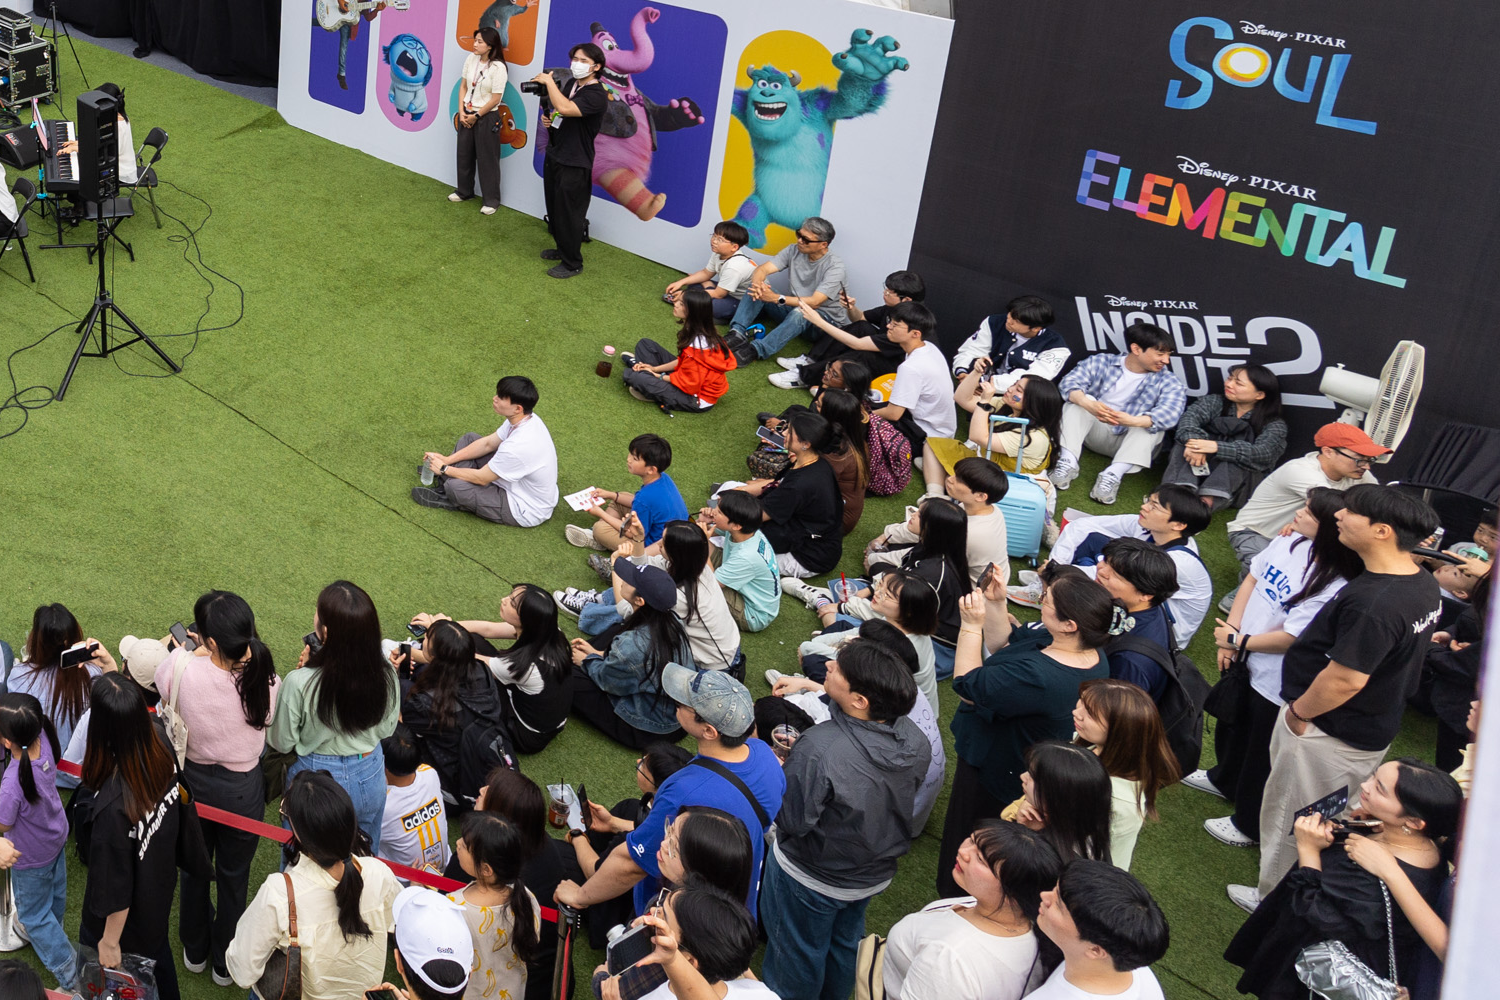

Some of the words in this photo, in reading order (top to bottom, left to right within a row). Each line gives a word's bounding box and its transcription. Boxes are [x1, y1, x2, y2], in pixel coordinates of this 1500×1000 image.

[1239, 20, 1288, 41] Disney
[1295, 32, 1347, 49] PIXAR
[1164, 16, 1378, 135] SOUL
[1176, 156, 1239, 186] Disney
[1249, 176, 1317, 200] PIXAR
[1075, 149, 1408, 289] ELEMENTAL
[1104, 294, 1149, 311] Disney
[1154, 299, 1199, 310] PIXAR
[404, 802, 440, 830] adidas
